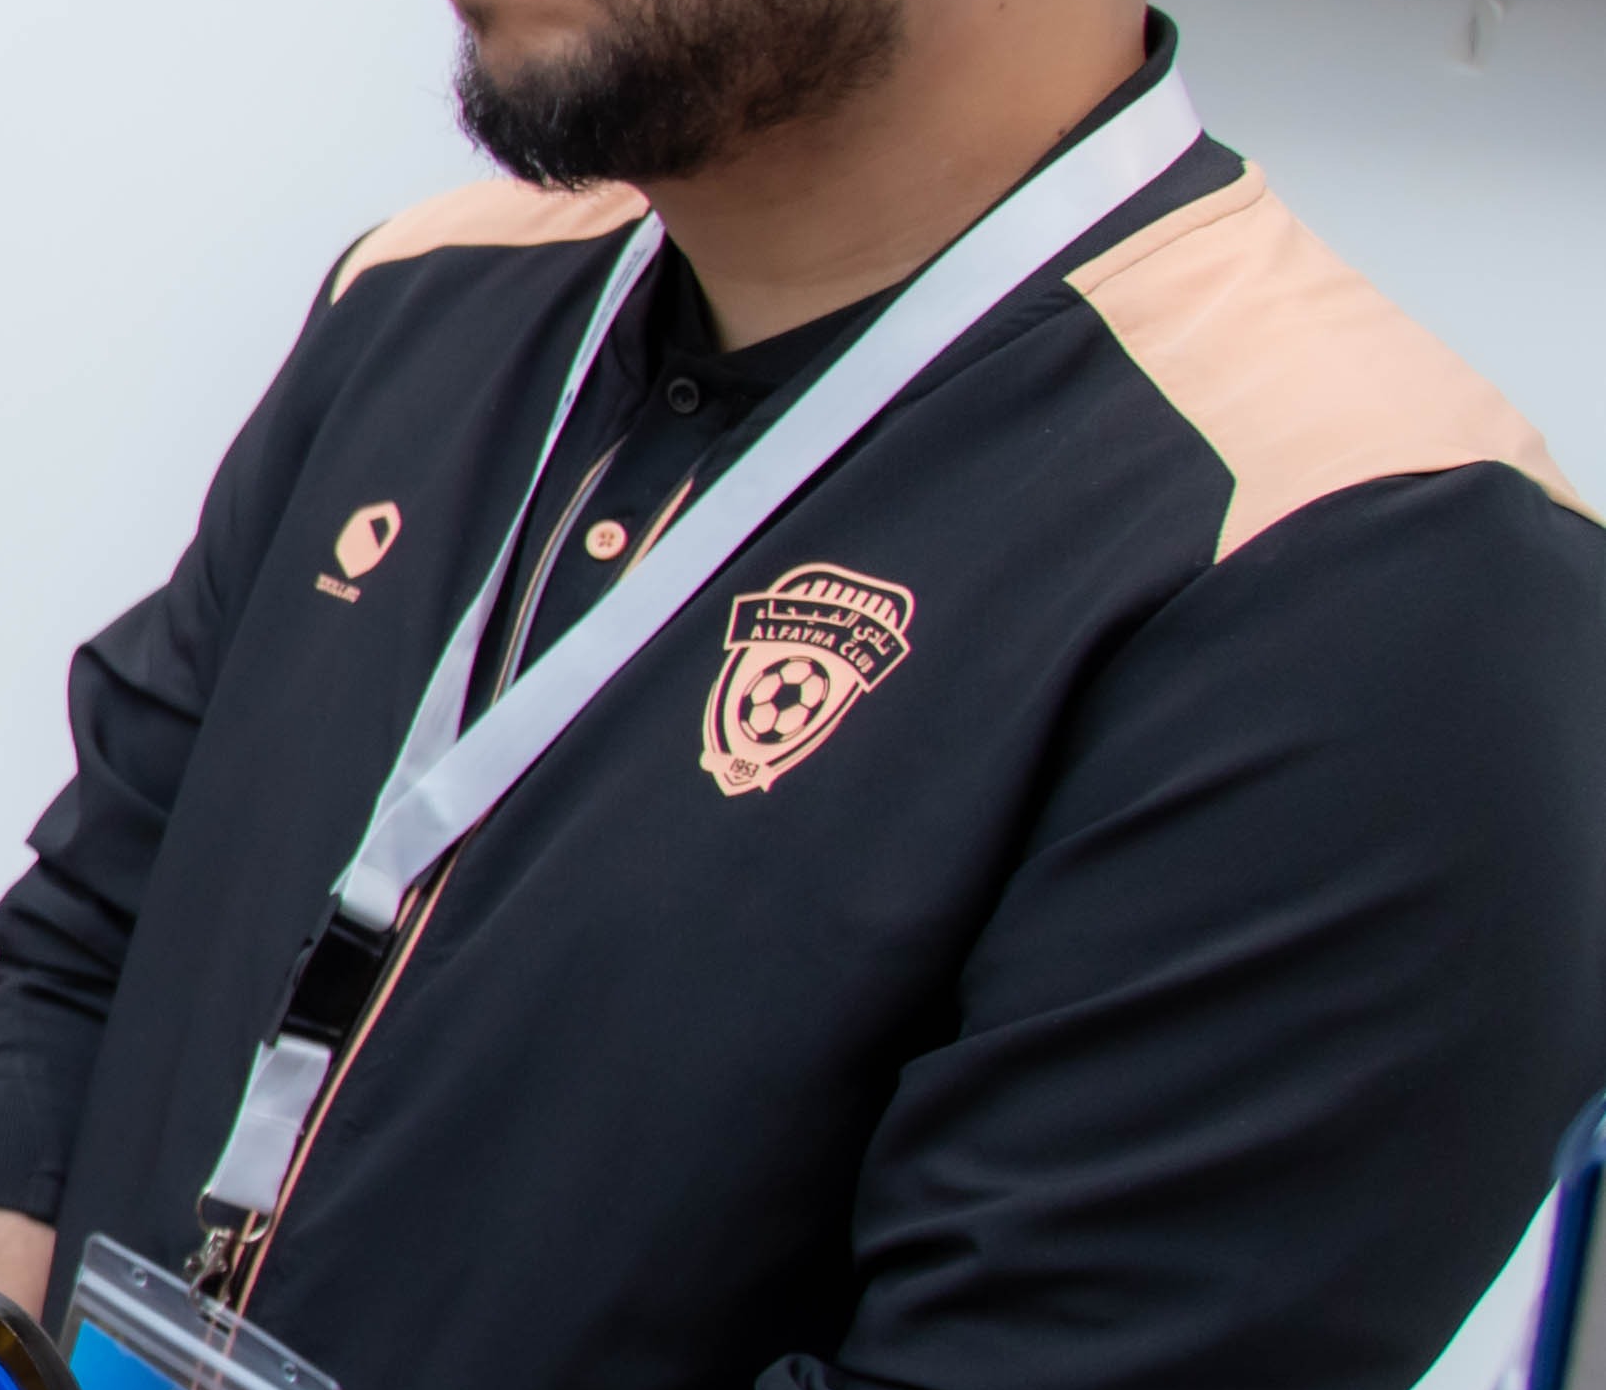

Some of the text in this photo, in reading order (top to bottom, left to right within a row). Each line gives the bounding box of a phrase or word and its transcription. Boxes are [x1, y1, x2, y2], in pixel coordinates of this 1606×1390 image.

[750, 624, 875, 673] ALFAYHA CLUB
[730, 758, 759, 778] 1953
